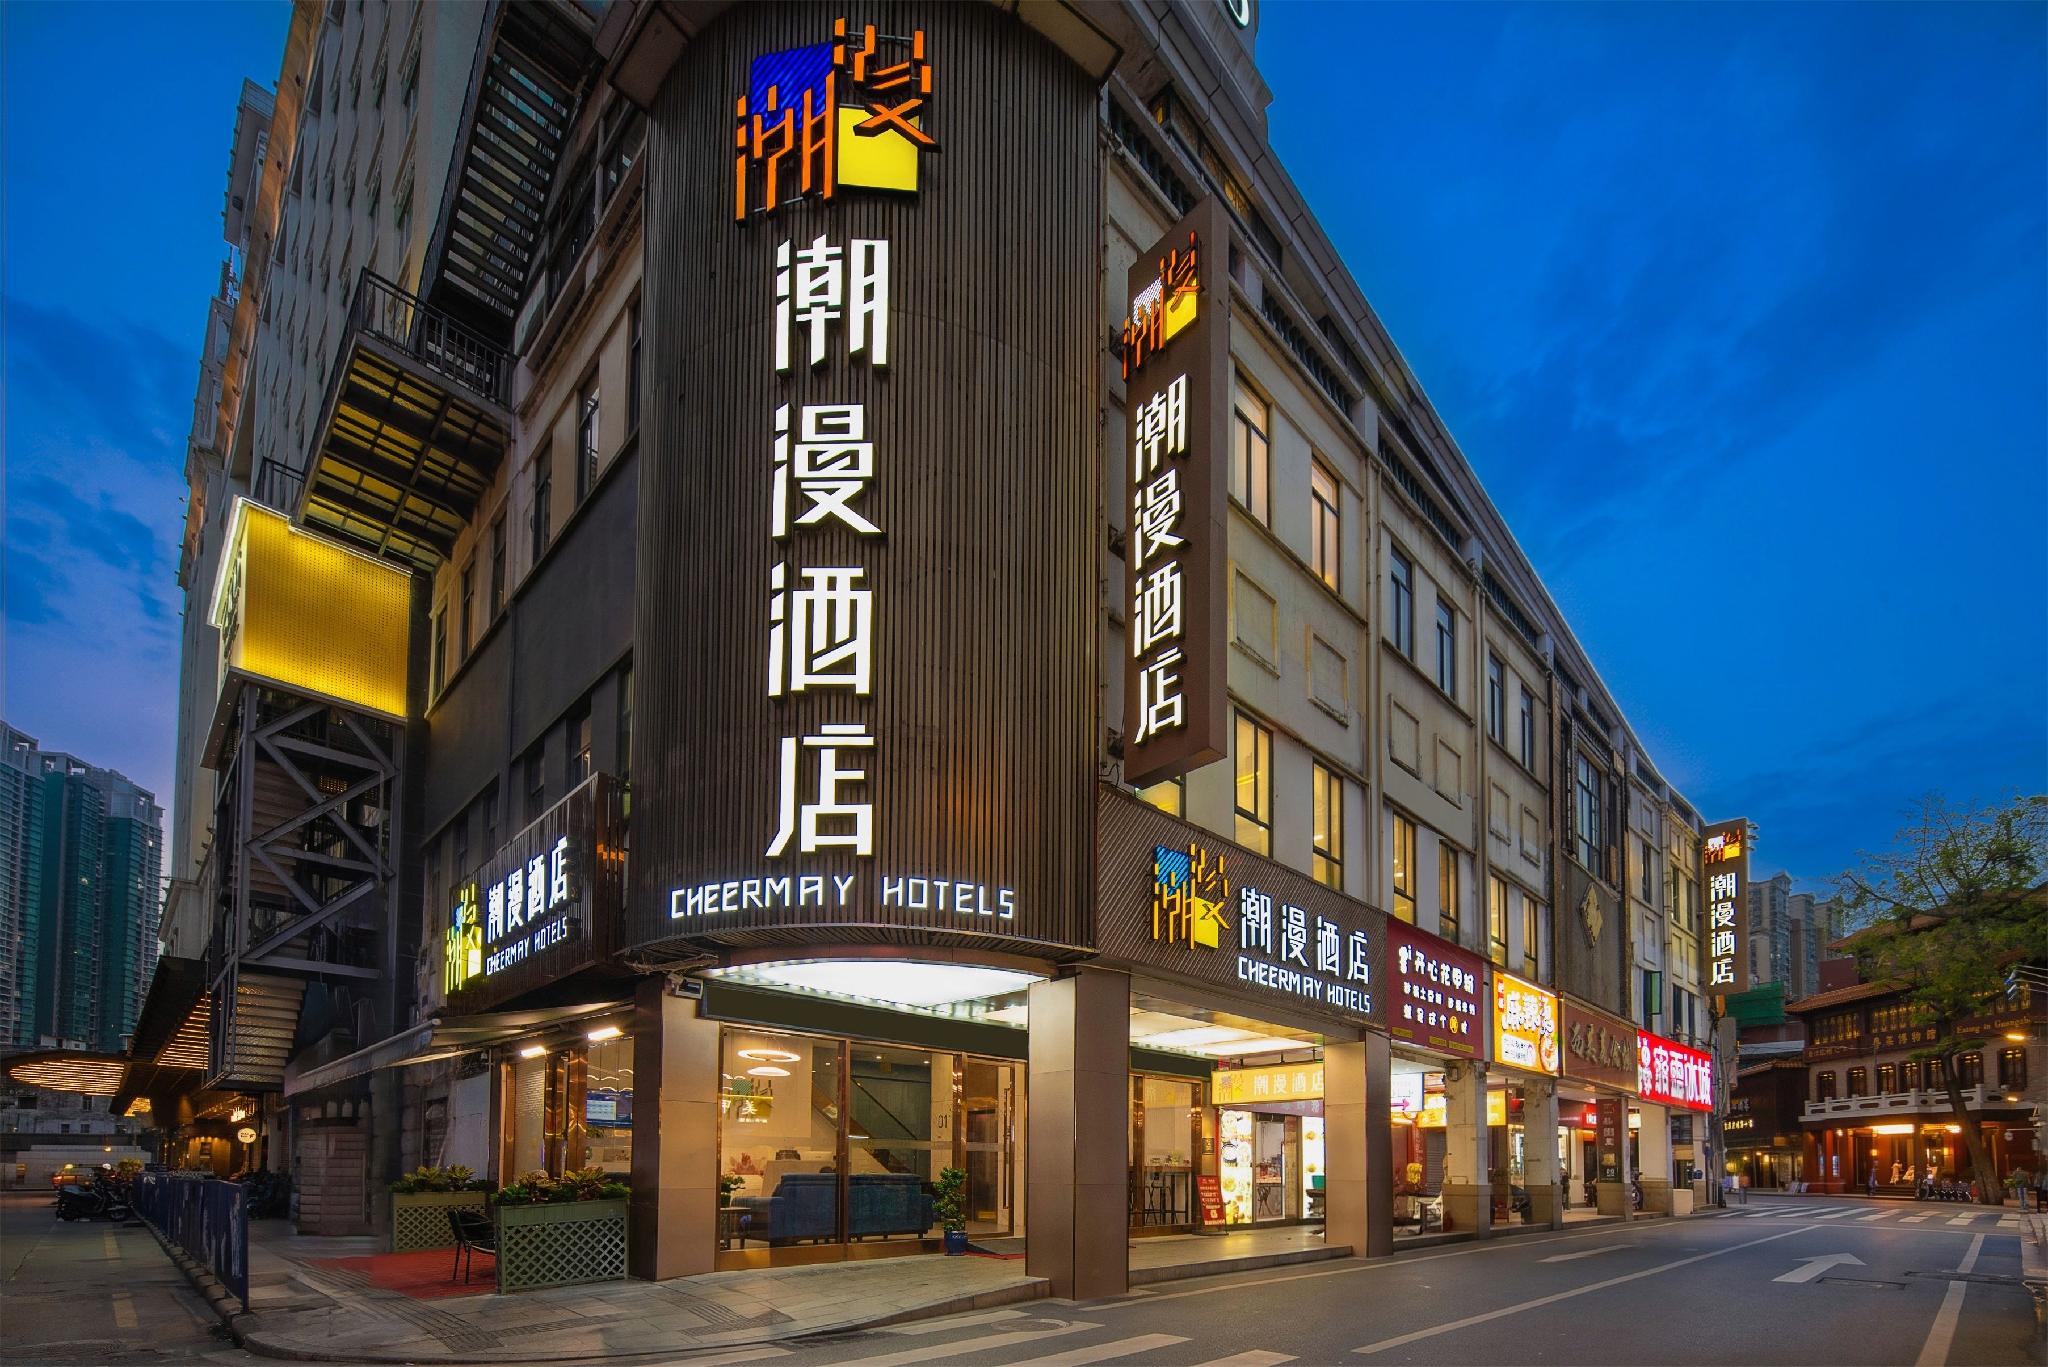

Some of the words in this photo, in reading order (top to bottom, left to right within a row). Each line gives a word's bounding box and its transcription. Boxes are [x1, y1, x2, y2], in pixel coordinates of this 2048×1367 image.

[765, 233, 890, 858] 潮漫酒店
[1134, 373, 1188, 745] 潮漫酒店
[487, 835, 568, 944] 潮漫酒店
[669, 874, 855, 920] CHEERMAY
[882, 875, 1015, 920] HOTELS
[1240, 887, 1370, 985] 潮漫酒店
[1709, 872, 1738, 986] 潮漫酒店
[486, 936, 530, 977] CHEERMAY
[534, 916, 568, 953] HOTELS
[1238, 956, 1323, 1000] CHEERMAY
[1327, 983, 1372, 1013] HOTELS
[1254, 1070, 1323, 1096] 潮漫酒店
